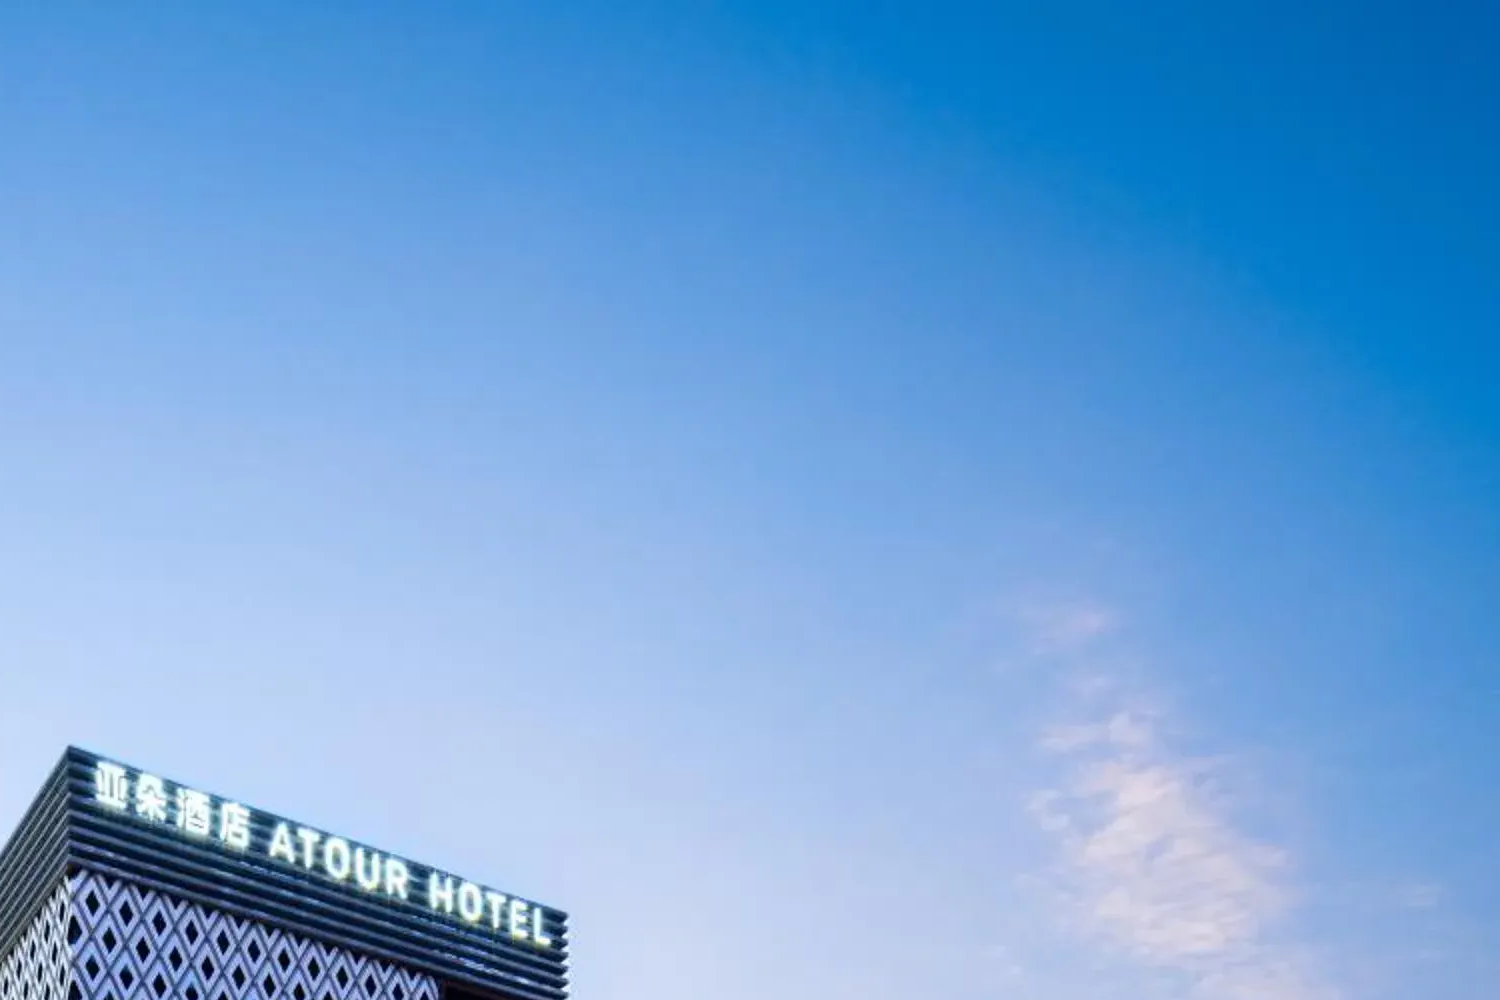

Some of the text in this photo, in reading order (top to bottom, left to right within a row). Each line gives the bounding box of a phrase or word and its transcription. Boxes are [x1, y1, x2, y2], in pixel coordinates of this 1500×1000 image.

[95, 762, 250, 849] 亚朵酒店
[268, 822, 552, 945] ATOUR HOTEL
